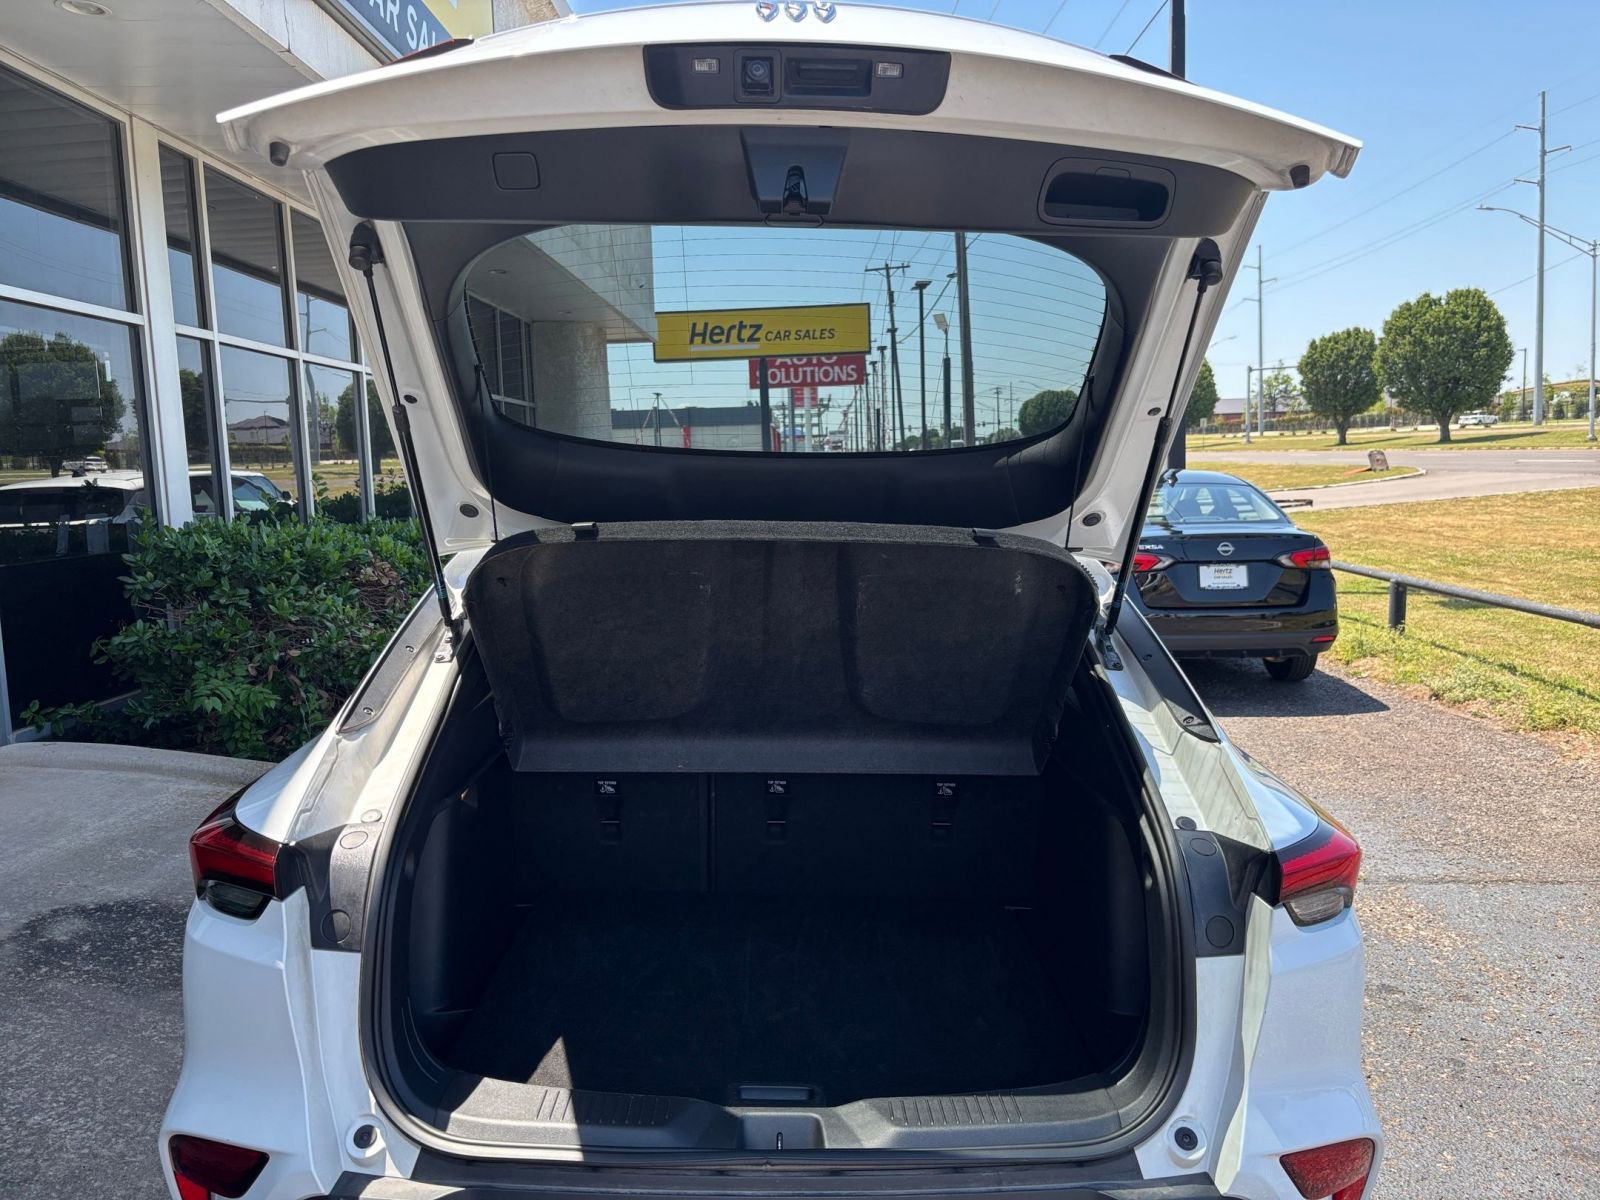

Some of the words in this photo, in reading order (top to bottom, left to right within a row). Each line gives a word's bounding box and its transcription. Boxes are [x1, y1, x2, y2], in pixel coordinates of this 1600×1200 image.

[689, 320, 763, 345] Hertz
[764, 330, 792, 343] CAR
[794, 328, 836, 341] SALES
[756, 364, 858, 385] OLUTIONS
